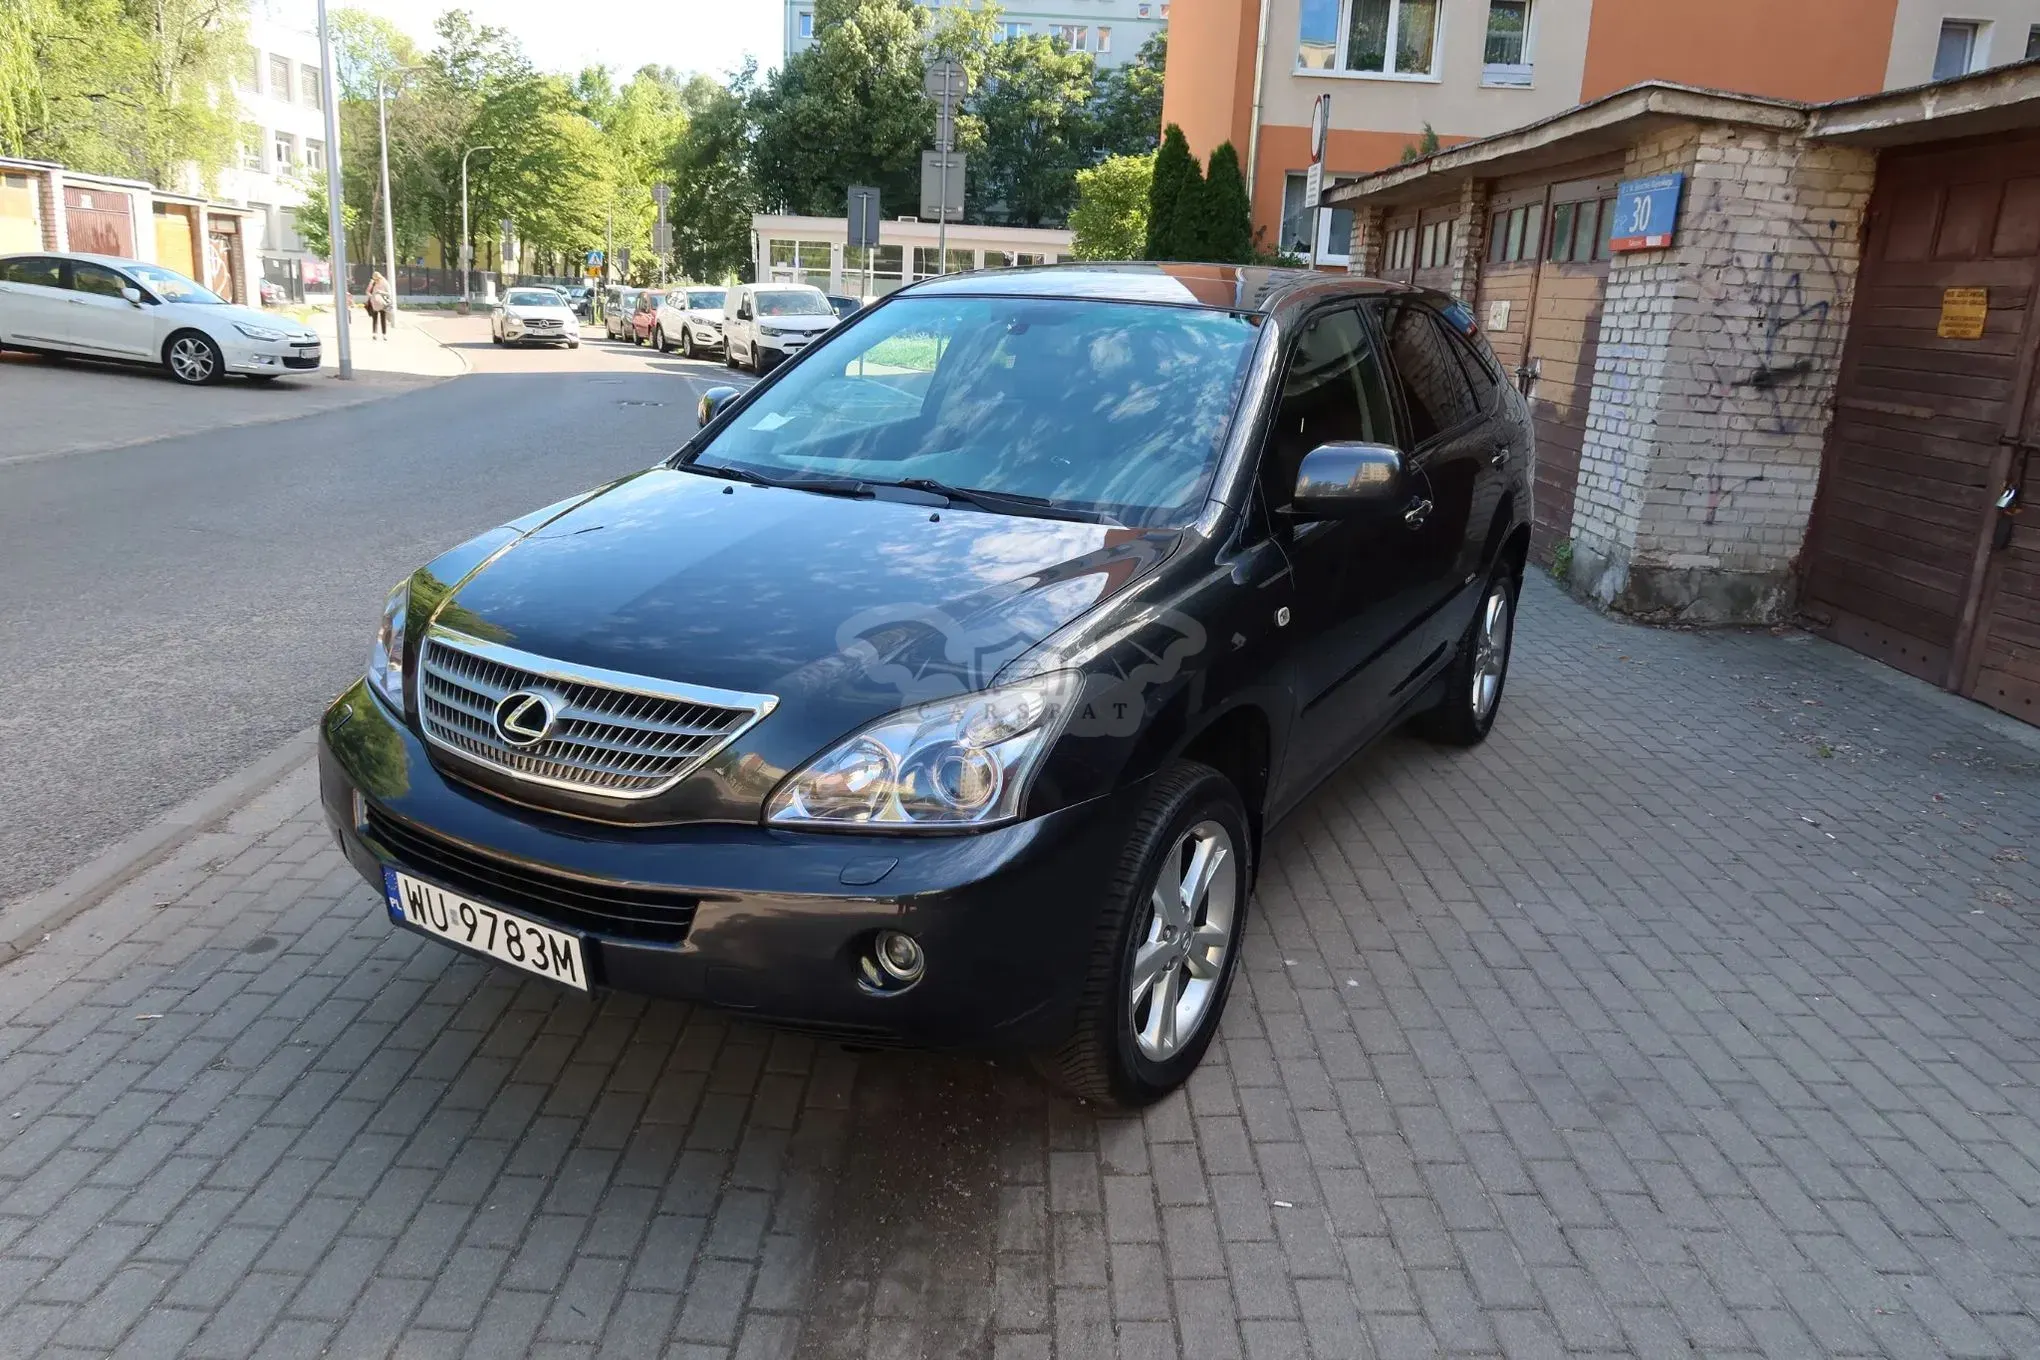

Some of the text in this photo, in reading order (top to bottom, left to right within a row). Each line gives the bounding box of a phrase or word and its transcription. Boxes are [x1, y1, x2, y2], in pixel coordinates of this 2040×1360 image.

[1628, 195, 1652, 233] 30
[389, 896, 403, 911] PL
[404, 878, 577, 983] WU 9783M
